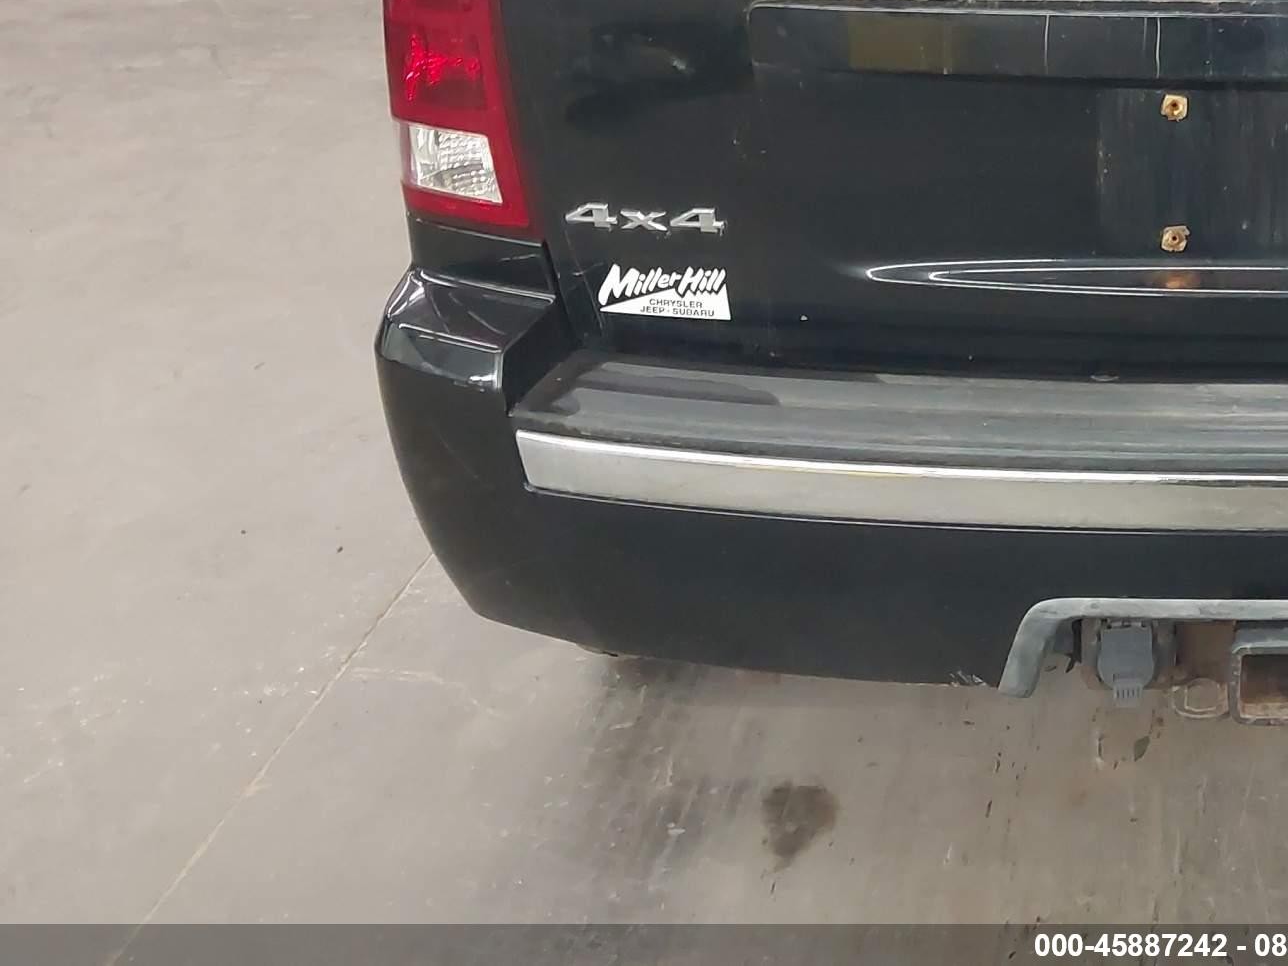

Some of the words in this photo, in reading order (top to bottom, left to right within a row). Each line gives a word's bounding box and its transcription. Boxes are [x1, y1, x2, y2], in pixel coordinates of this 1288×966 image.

[598, 263, 682, 306] Miller
[677, 266, 727, 295] Hill
[649, 298, 703, 309] CHRYSLER
[640, 305, 665, 314] JEEP
[672, 308, 715, 317] SUBARU
